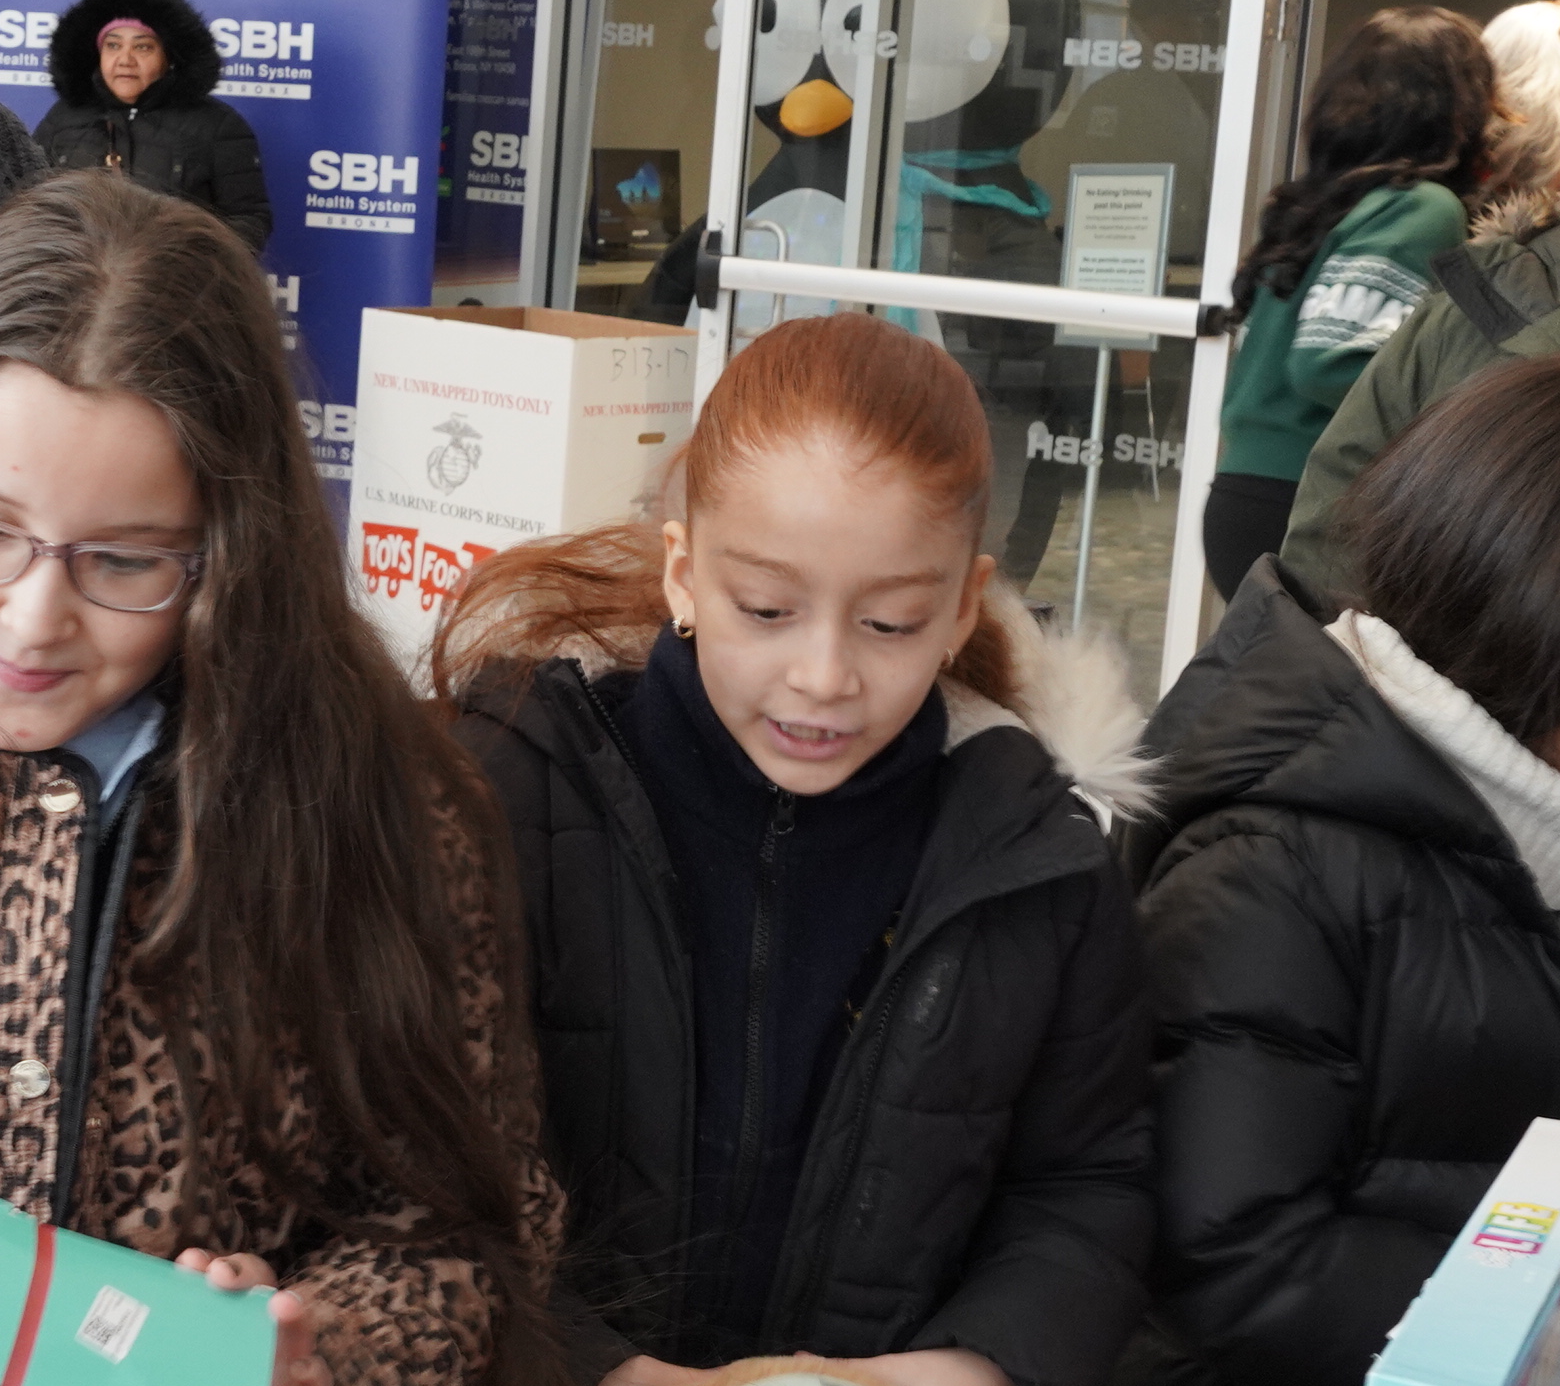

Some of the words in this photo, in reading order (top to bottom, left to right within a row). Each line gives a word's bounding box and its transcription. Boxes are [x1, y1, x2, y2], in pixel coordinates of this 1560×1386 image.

[214, 19, 314, 61] SBH
[601, 21, 655, 48] SBH
[219, 63, 252, 77] alth
[258, 63, 312, 80] System
[1153, 42, 1227, 74] SBH
[308, 150, 418, 194] SBH
[467, 169, 501, 184] Health
[306, 193, 356, 209] Health
[361, 196, 415, 213] System
[373, 372, 400, 390] NEW,
[402, 377, 480, 404] UNWRAPPED
[480, 390, 515, 410] TOYS
[516, 396, 554, 417] ONLY
[607, 403, 669, 417] UNWRAPPED
[298, 399, 357, 442] SB
[1113, 433, 1184, 471] SBH
[364, 486, 385, 503] U.S.
[387, 490, 439, 514] MARINE
[440, 502, 484, 524] CORPS
[485, 512, 547, 535] RESERVE
[366, 533, 414, 575] TOYS
[1474, 1202, 1558, 1254] LIFE
